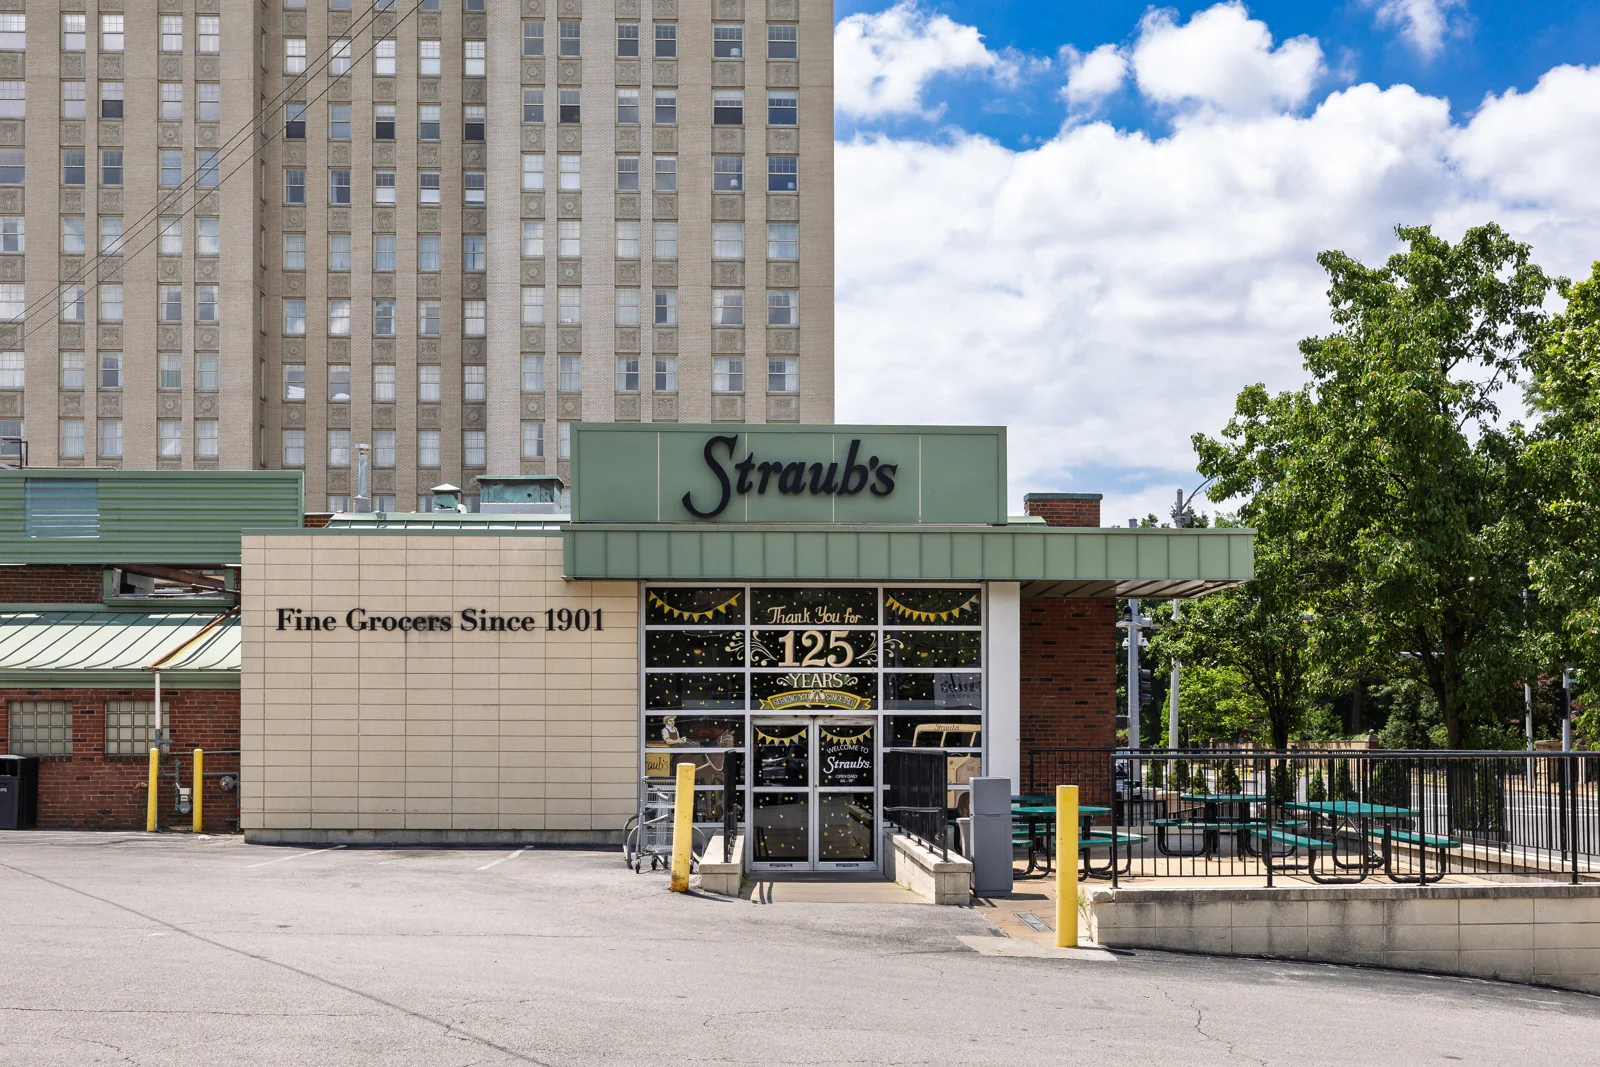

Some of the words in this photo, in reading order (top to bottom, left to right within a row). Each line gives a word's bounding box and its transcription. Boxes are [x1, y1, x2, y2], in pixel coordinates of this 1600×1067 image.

[682, 434, 898, 518] Straub's
[276, 608, 337, 631] Fine
[346, 608, 452, 632] Grocers
[460, 608, 535, 632] Since
[544, 608, 604, 632] 1901
[767, 605, 811, 624] Thank
[814, 606, 840, 624] You
[844, 607, 863, 624] for
[778, 630, 854, 667] 125
[788, 673, 844, 688] YEARS
[826, 744, 860, 754] WELCOME
[860, 746, 869, 754] TO
[822, 756, 870, 774] Straub's
